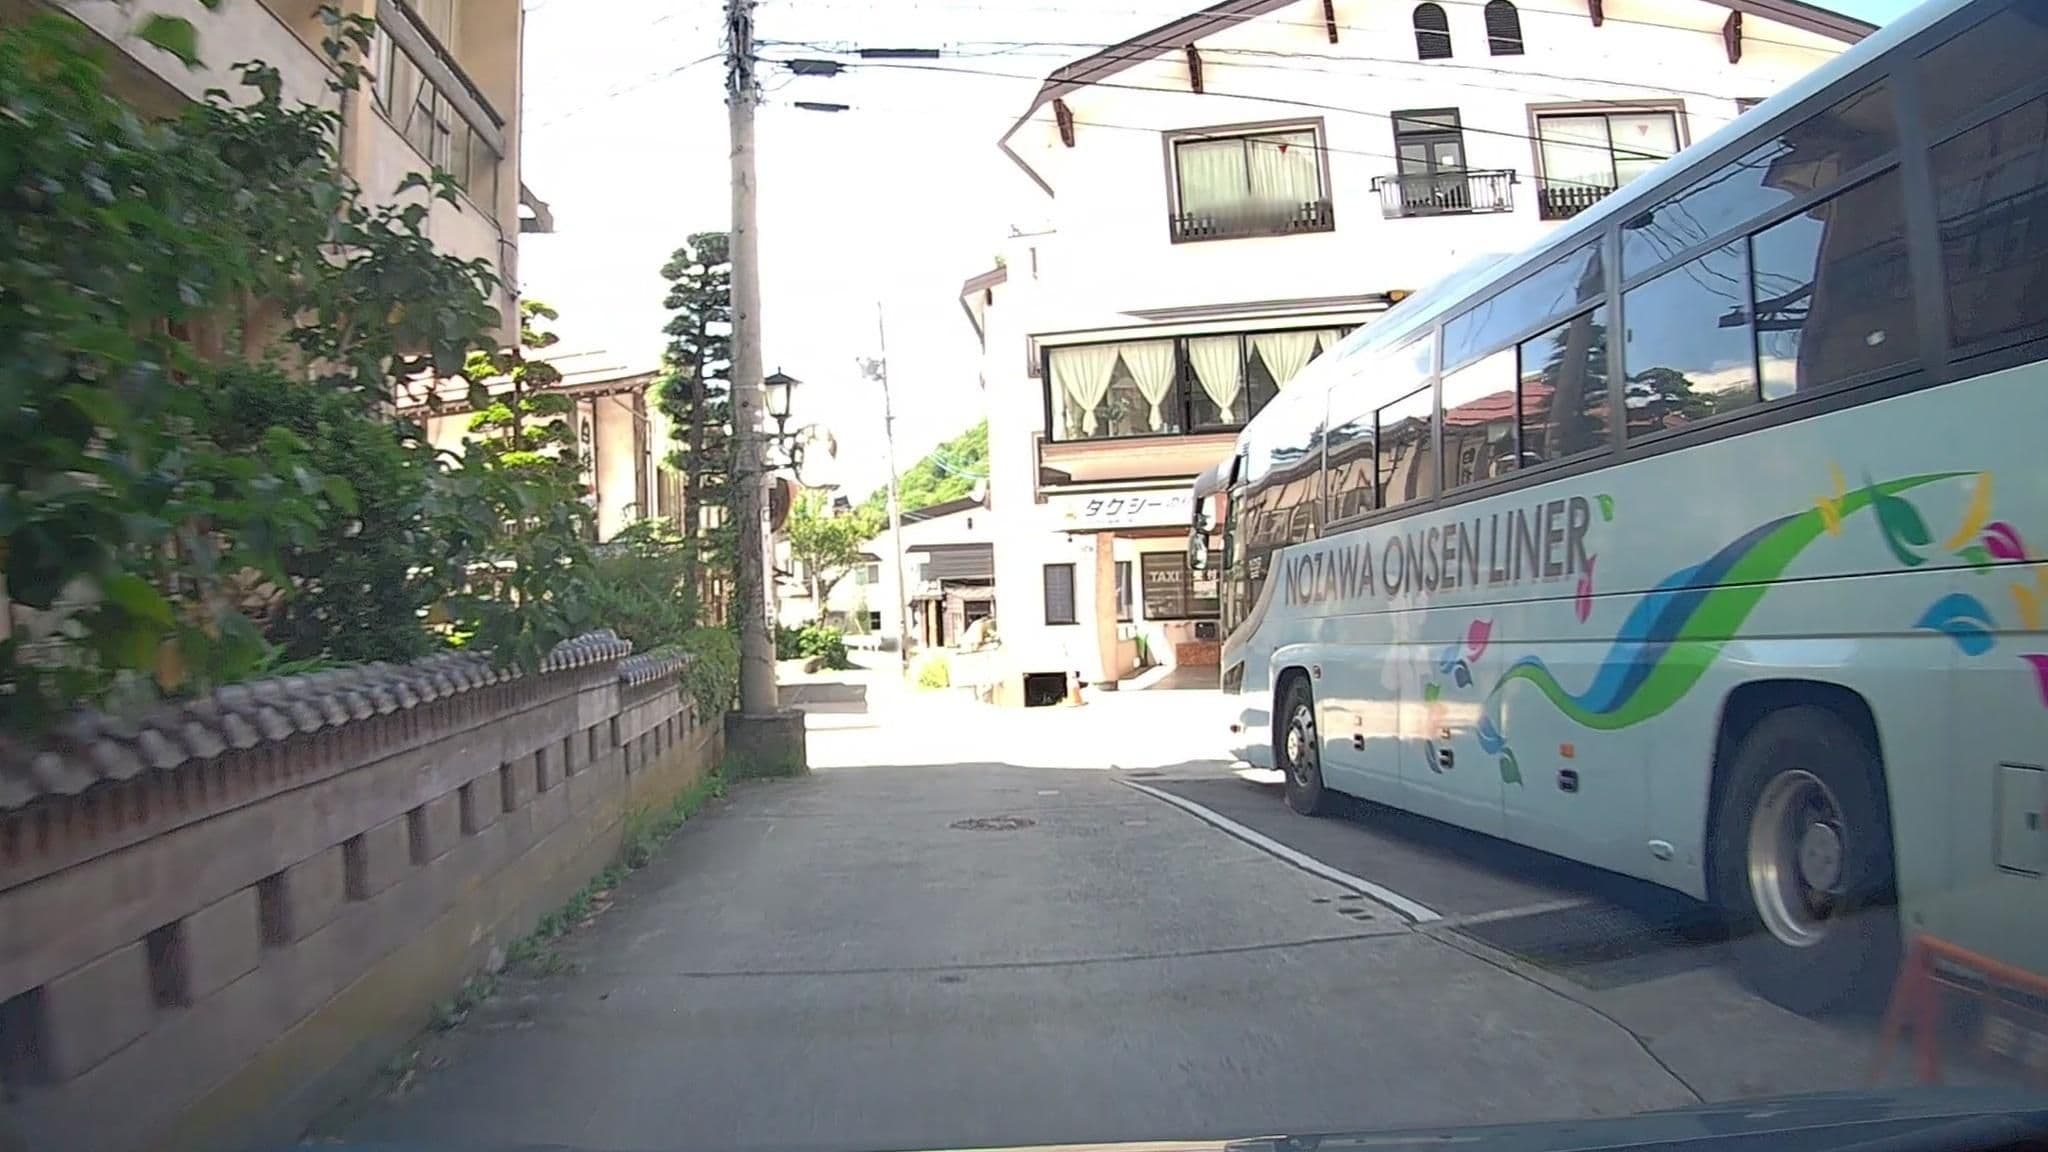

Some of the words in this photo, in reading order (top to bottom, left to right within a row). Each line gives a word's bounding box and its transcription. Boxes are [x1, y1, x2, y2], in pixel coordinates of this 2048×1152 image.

[1149, 570, 1180, 583] TAXI
[1284, 541, 1376, 607] NOZAWA
[1382, 518, 1481, 597] ONSEN
[1488, 496, 1591, 583] LINER
